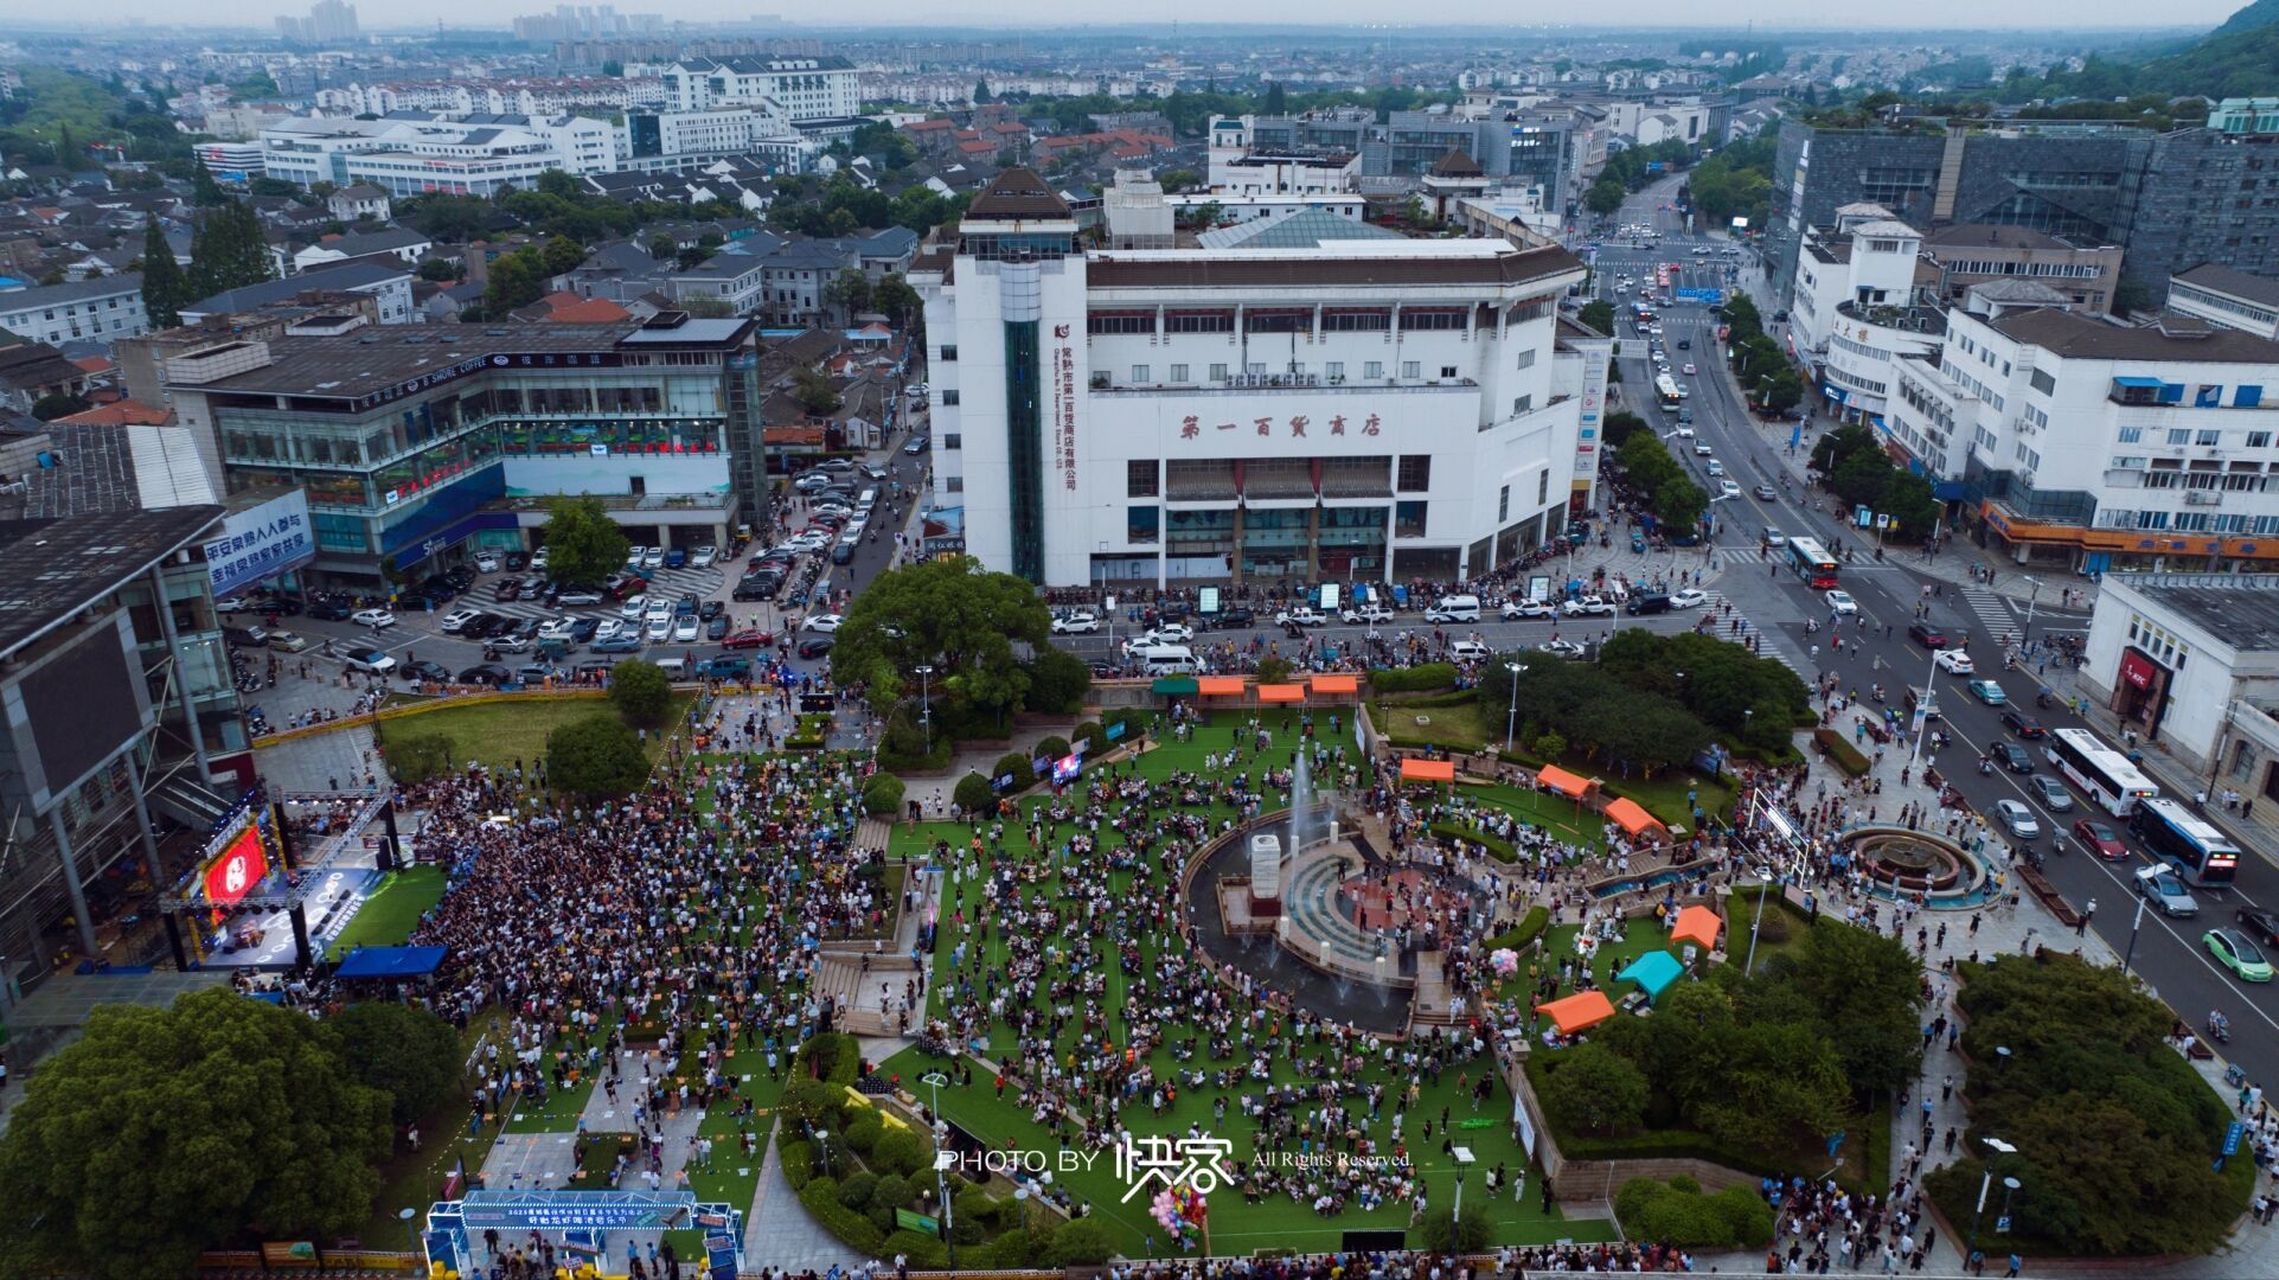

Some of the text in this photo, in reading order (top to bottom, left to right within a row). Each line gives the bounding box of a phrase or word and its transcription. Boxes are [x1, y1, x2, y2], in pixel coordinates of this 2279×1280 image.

[460, 356, 486, 374] COFFEE
[206, 514, 301, 561] 平安常熟人人参与
[2132, 672, 2146, 685] KFC
